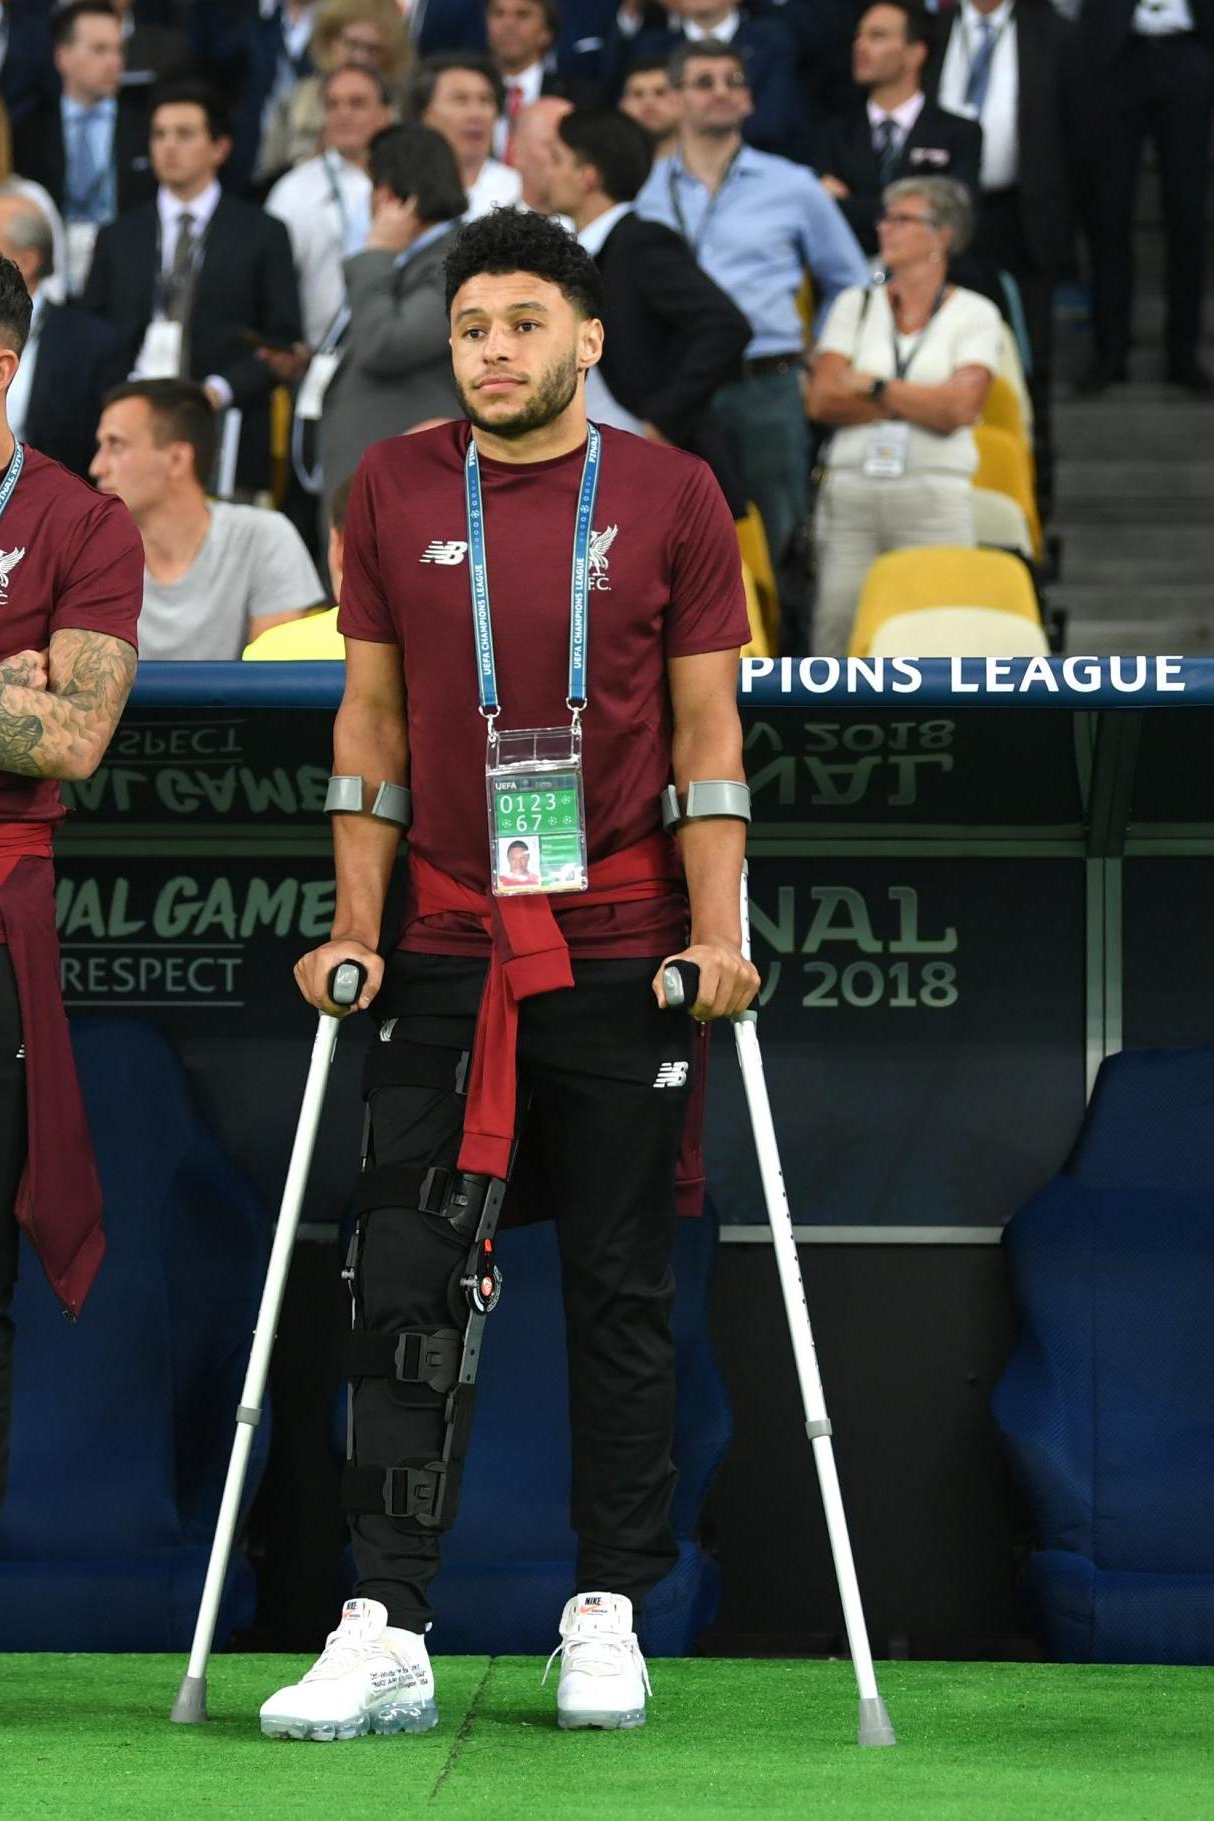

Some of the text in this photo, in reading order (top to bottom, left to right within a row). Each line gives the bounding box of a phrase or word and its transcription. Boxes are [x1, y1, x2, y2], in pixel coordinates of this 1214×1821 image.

[474, 564, 492, 675] UEFA CHAMPIONS LEAGUE
[574, 557, 585, 669] UEFA CHAMPIONS LEAGUE
[951, 656, 1186, 693] LEAGUE
[495, 781, 517, 791] UEFA
[152, 876, 336, 940] GAME
[60, 957, 243, 993] RESPECT
[802, 961, 959, 1008] 2018
[584, 1597, 601, 1606] NIKE
